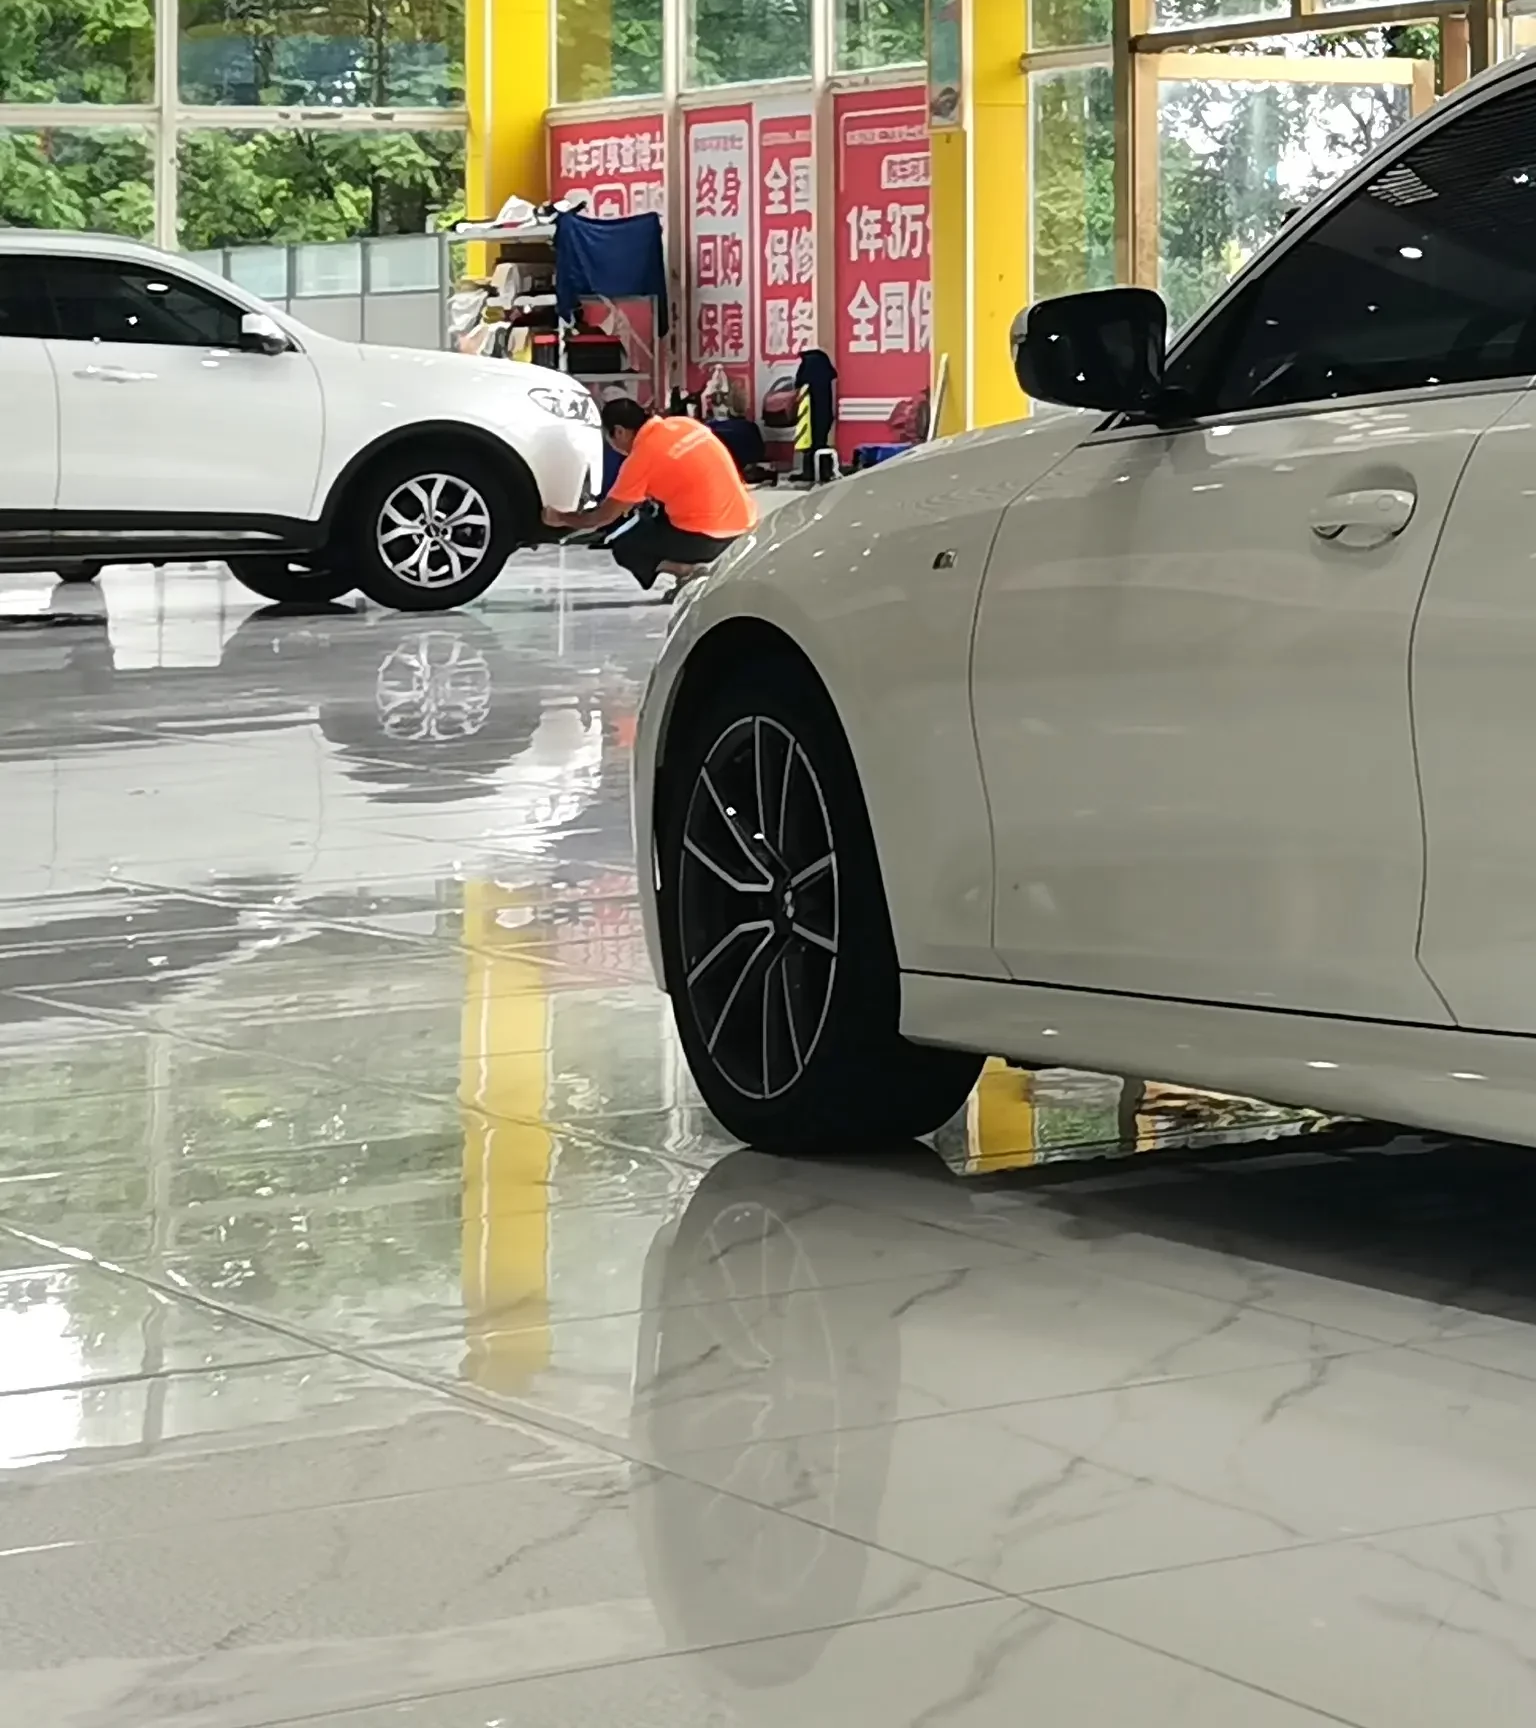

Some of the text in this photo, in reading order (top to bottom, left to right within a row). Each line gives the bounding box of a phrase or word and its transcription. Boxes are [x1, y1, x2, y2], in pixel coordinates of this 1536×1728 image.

[696, 162, 742, 218] 终身
[764, 157, 812, 215] 全国
[696, 232, 743, 289] 回购
[764, 226, 814, 287] 保修
[846, 202, 933, 263] 1年3万
[697, 300, 745, 359] 保障
